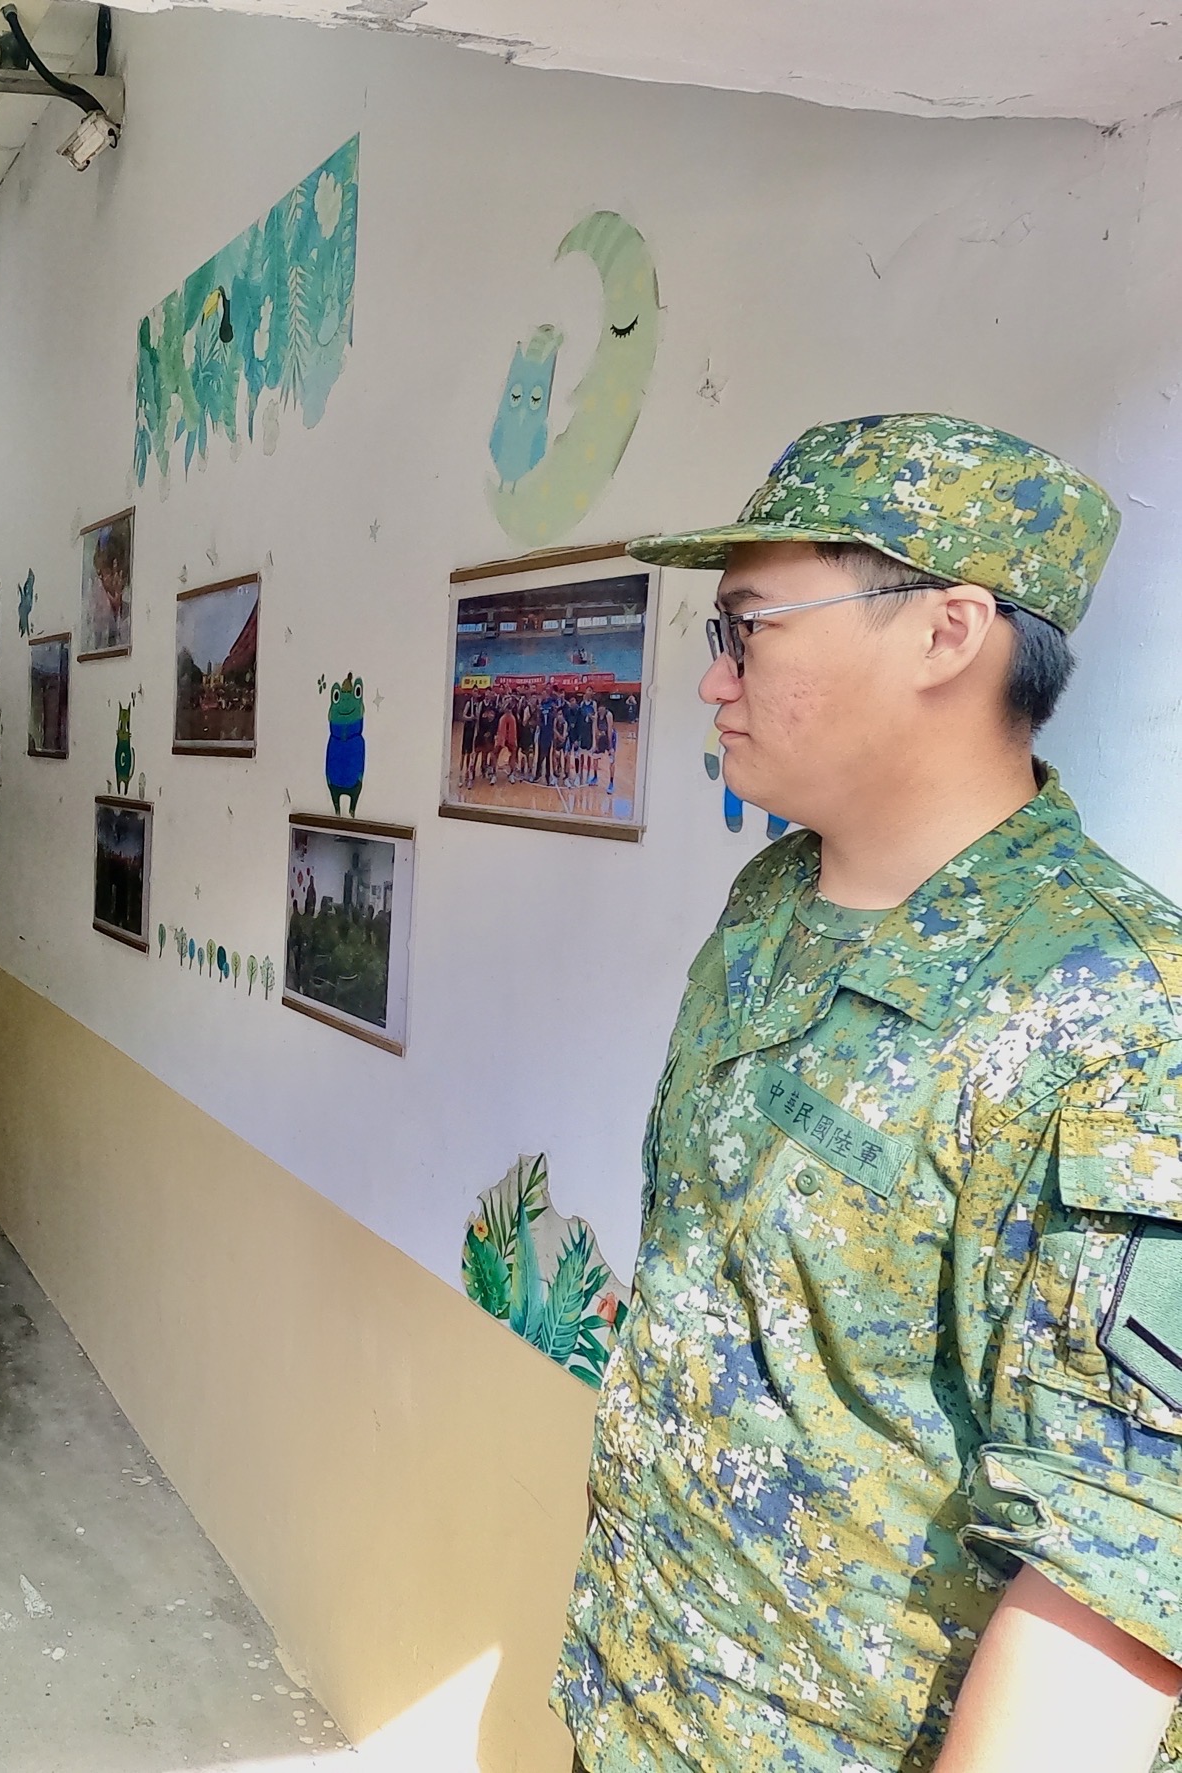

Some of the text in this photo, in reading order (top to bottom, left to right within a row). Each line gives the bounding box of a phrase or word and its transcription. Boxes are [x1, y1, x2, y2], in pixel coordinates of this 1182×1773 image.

[769, 1079, 884, 1171] 中華民國陸軍
